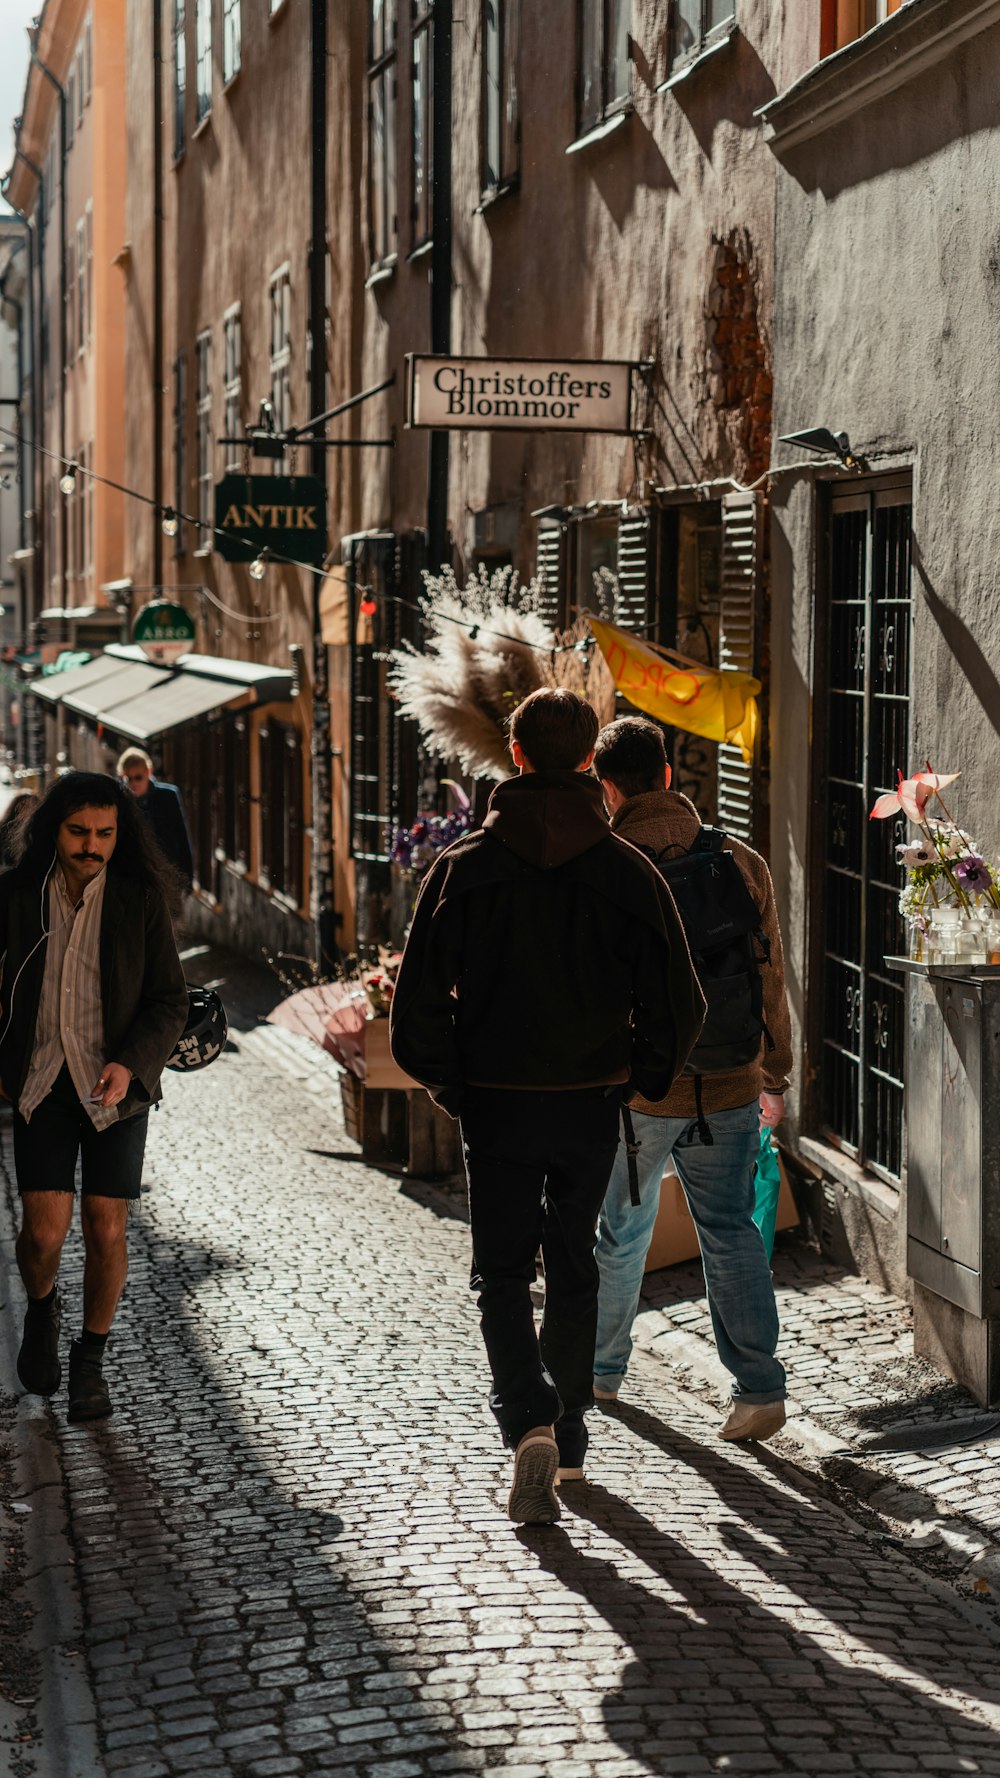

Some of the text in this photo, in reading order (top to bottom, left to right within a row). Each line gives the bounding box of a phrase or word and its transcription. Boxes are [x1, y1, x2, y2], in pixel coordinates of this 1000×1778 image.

[434, 366, 612, 399] Christoffers
[445, 391, 580, 419] Blommor
[222, 504, 318, 529] ANTIK
[165, 1043, 220, 1068] TRY
[178, 1035, 199, 1052] ME
